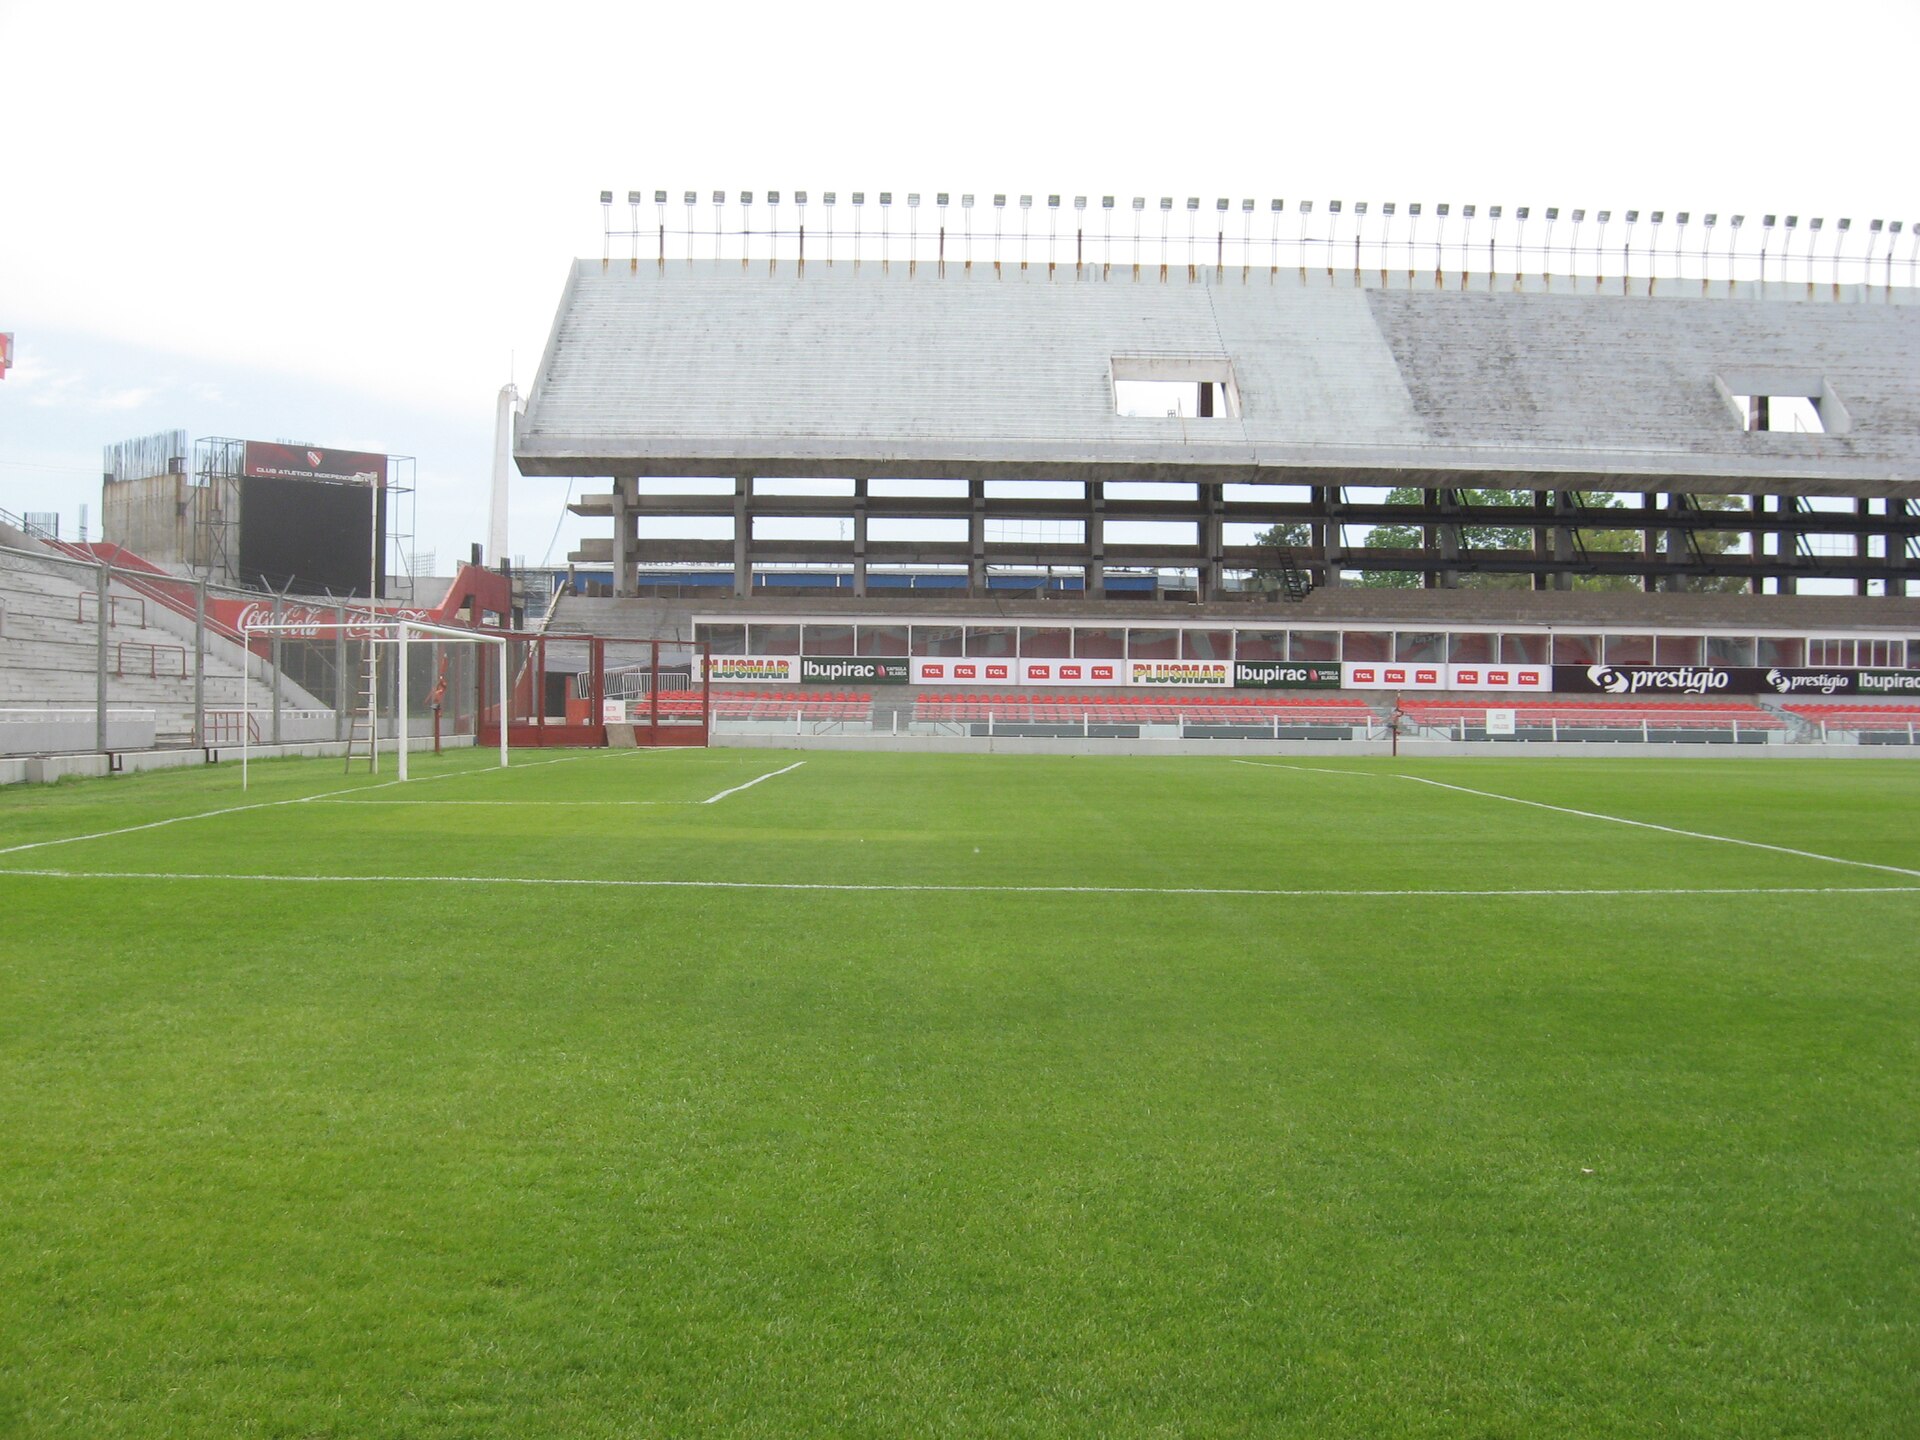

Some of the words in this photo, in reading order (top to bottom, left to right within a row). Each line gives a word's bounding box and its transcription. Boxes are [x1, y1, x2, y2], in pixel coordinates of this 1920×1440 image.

[278, 469, 313, 477] ATLETICO
[237, 602, 321, 635] CocaCola
[700, 659, 789, 679] PLUSMAR
[803, 660, 875, 680] Ibupirac
[1133, 664, 1225, 684] PLUSMAR
[1236, 664, 1307, 684] Ibupirac
[1631, 667, 1729, 694] prestigio
[1791, 674, 1849, 694] prestigio
[1858, 672, 1920, 691] Ibupirac
